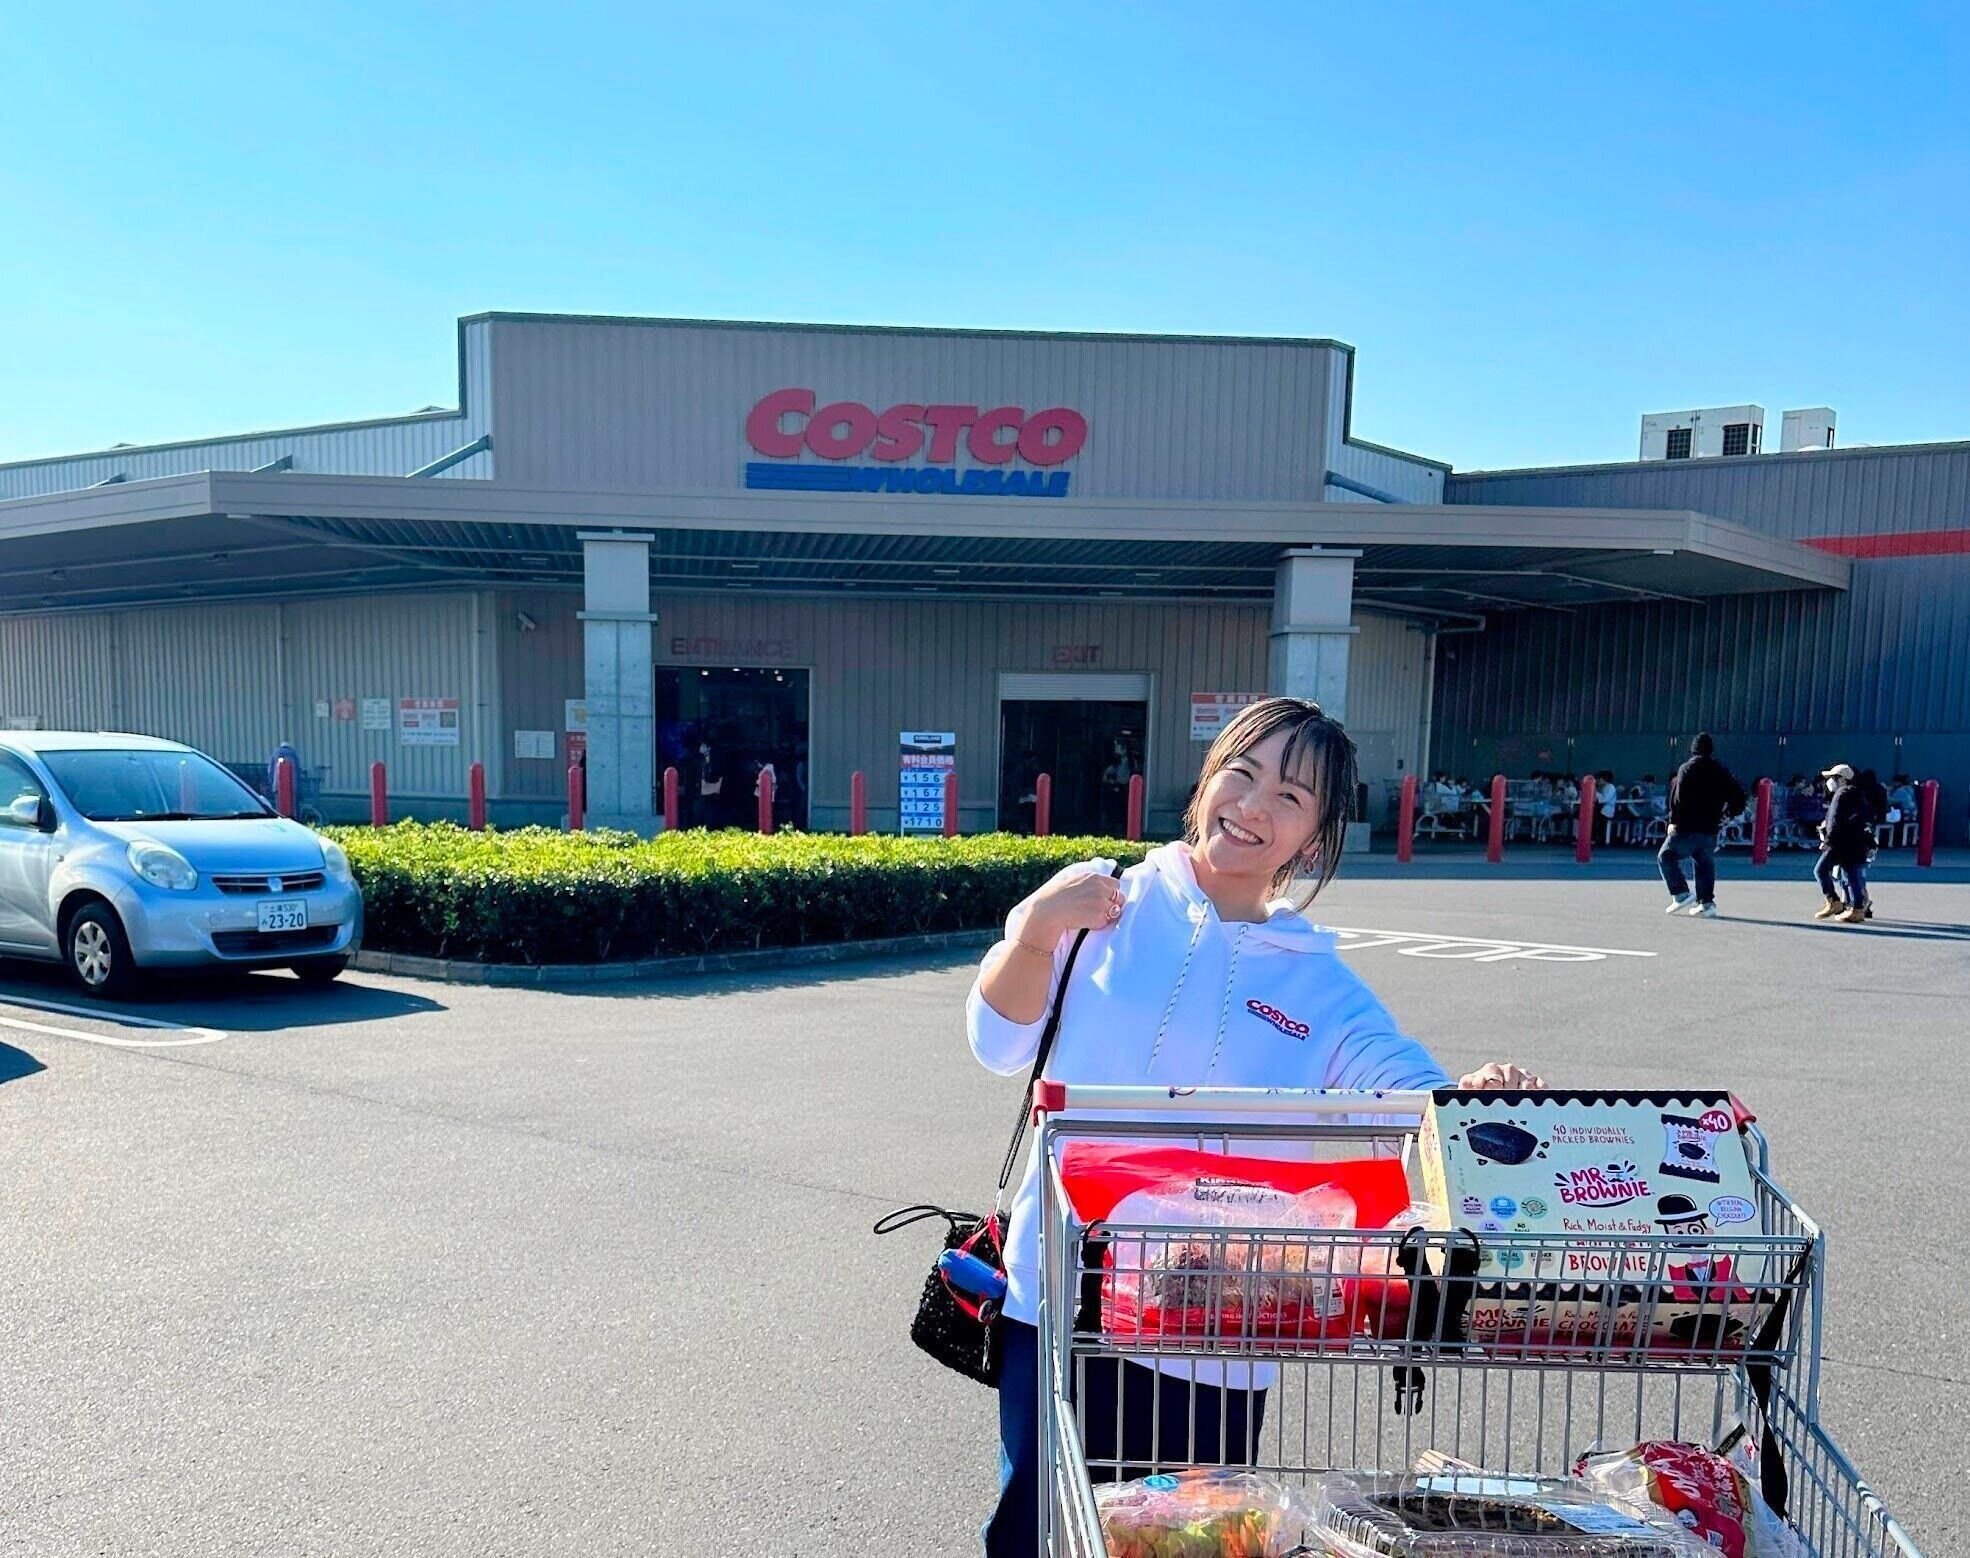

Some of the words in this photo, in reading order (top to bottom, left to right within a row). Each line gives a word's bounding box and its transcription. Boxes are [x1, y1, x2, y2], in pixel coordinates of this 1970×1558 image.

[746, 388, 1088, 466] COSTCO
[850, 466, 1070, 497] WHOLESALE
[269, 912, 304, 929] 23-20
[1246, 999, 1310, 1034] COSTCO
[1553, 1124, 1567, 1135] 40
[1569, 1126, 1627, 1135] INDIVIDUALLY
[1552, 1135, 1586, 1144] PACKED
[1588, 1135, 1635, 1144] BROWNIES
[1570, 1167, 1608, 1186] MR.
[1560, 1180, 1651, 1204] BROWNIE
[1587, 1218, 1616, 1231] Moist
[1628, 1218, 1651, 1234] Fudgy
[1471, 1318, 1550, 1329] ROWNIE
